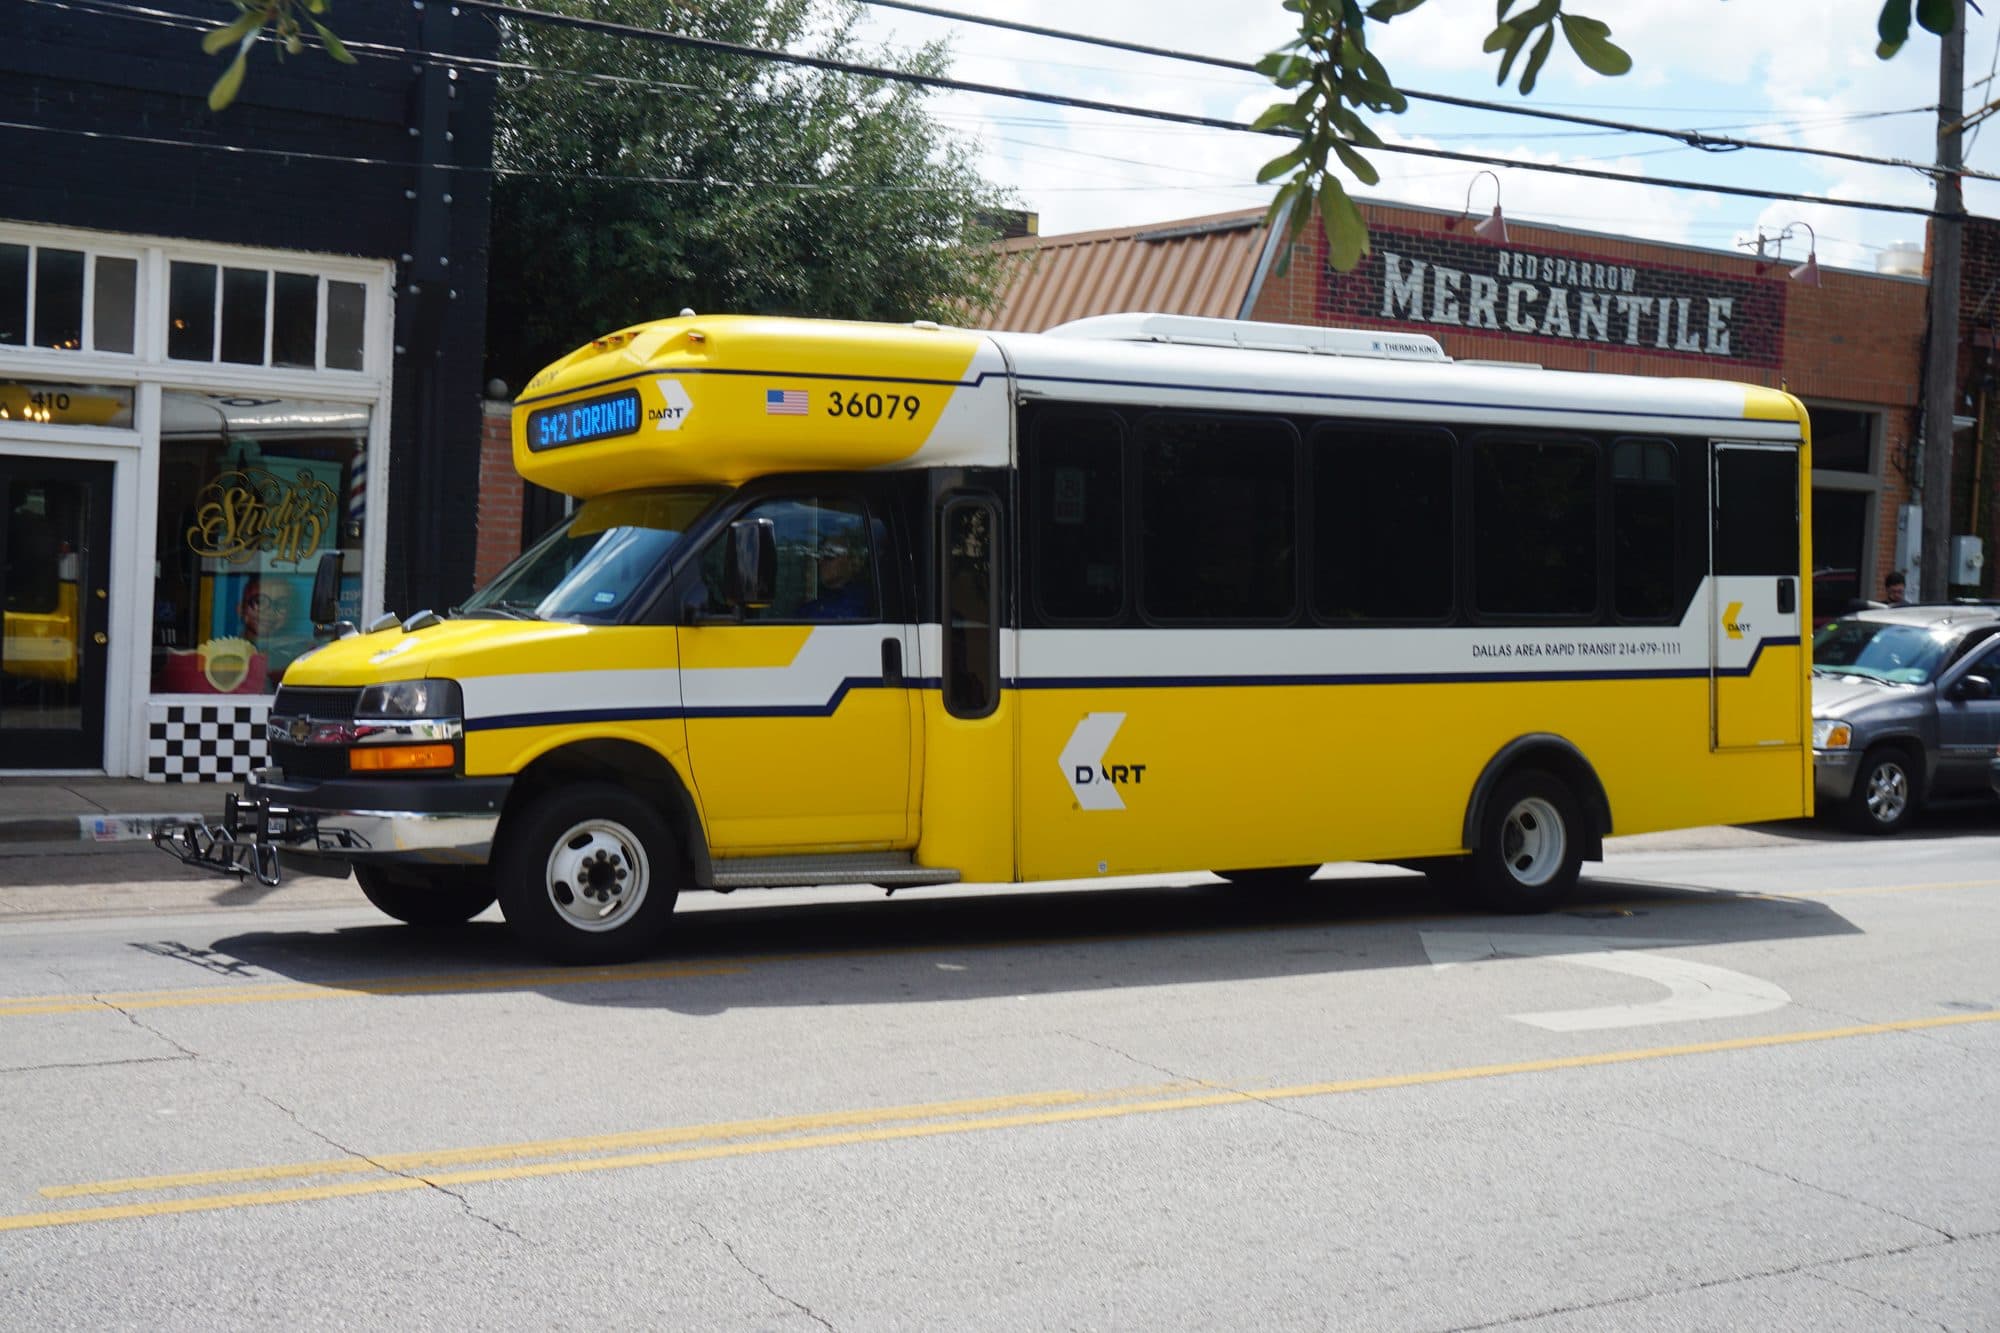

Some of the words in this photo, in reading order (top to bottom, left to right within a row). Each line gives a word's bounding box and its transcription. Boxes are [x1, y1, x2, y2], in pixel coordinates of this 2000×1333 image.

[1498, 250, 1538, 281] RED
[1542, 258, 1637, 293] SPARROW
[1379, 251, 1736, 356] MERCANTILE
[1384, 342, 1418, 353] THERMO
[1418, 344, 1438, 354] KING
[31, 391, 70, 410] 410
[827, 391, 921, 421] 36079
[539, 411, 568, 445] 542
[571, 397, 635, 438] CORINTH
[648, 407, 684, 420] DART
[1727, 623, 1752, 632] DART
[1472, 644, 1512, 657] DALLAS
[1514, 643, 1542, 657] AREA
[1545, 643, 1575, 656] RAPID
[1577, 642, 1616, 656] TRANSIT
[1618, 642, 1681, 656] 214-979-1111
[1075, 764, 1147, 785] DART
